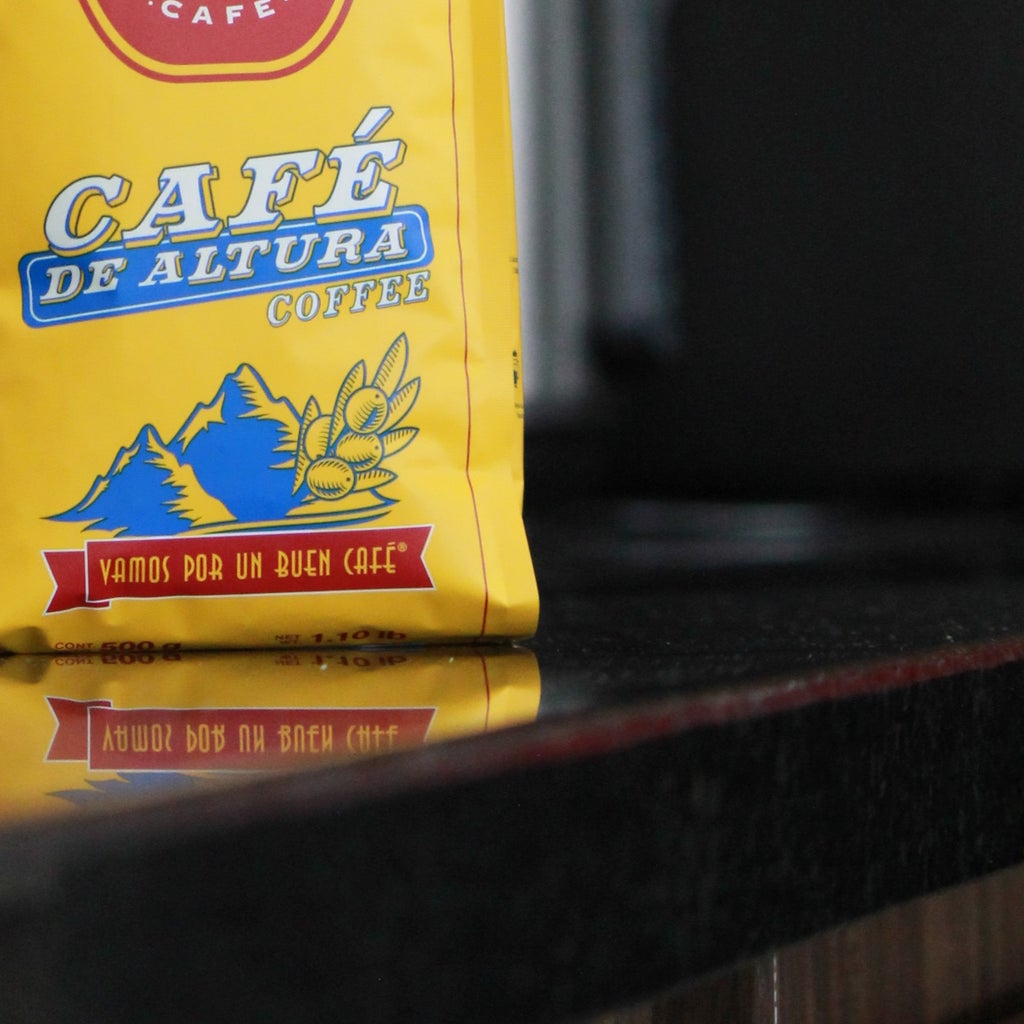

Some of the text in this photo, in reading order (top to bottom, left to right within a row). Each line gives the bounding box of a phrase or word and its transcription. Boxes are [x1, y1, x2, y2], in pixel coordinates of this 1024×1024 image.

[43, 106, 408, 257] CAFÉ
[40, 221, 409, 305] DE ALTURA
[266, 270, 430, 328] COFFEE
[99, 555, 171, 586] VAMOS
[183, 553, 224, 582] POR
[236, 551, 263, 580] UN
[274, 548, 331, 578] BUEN
